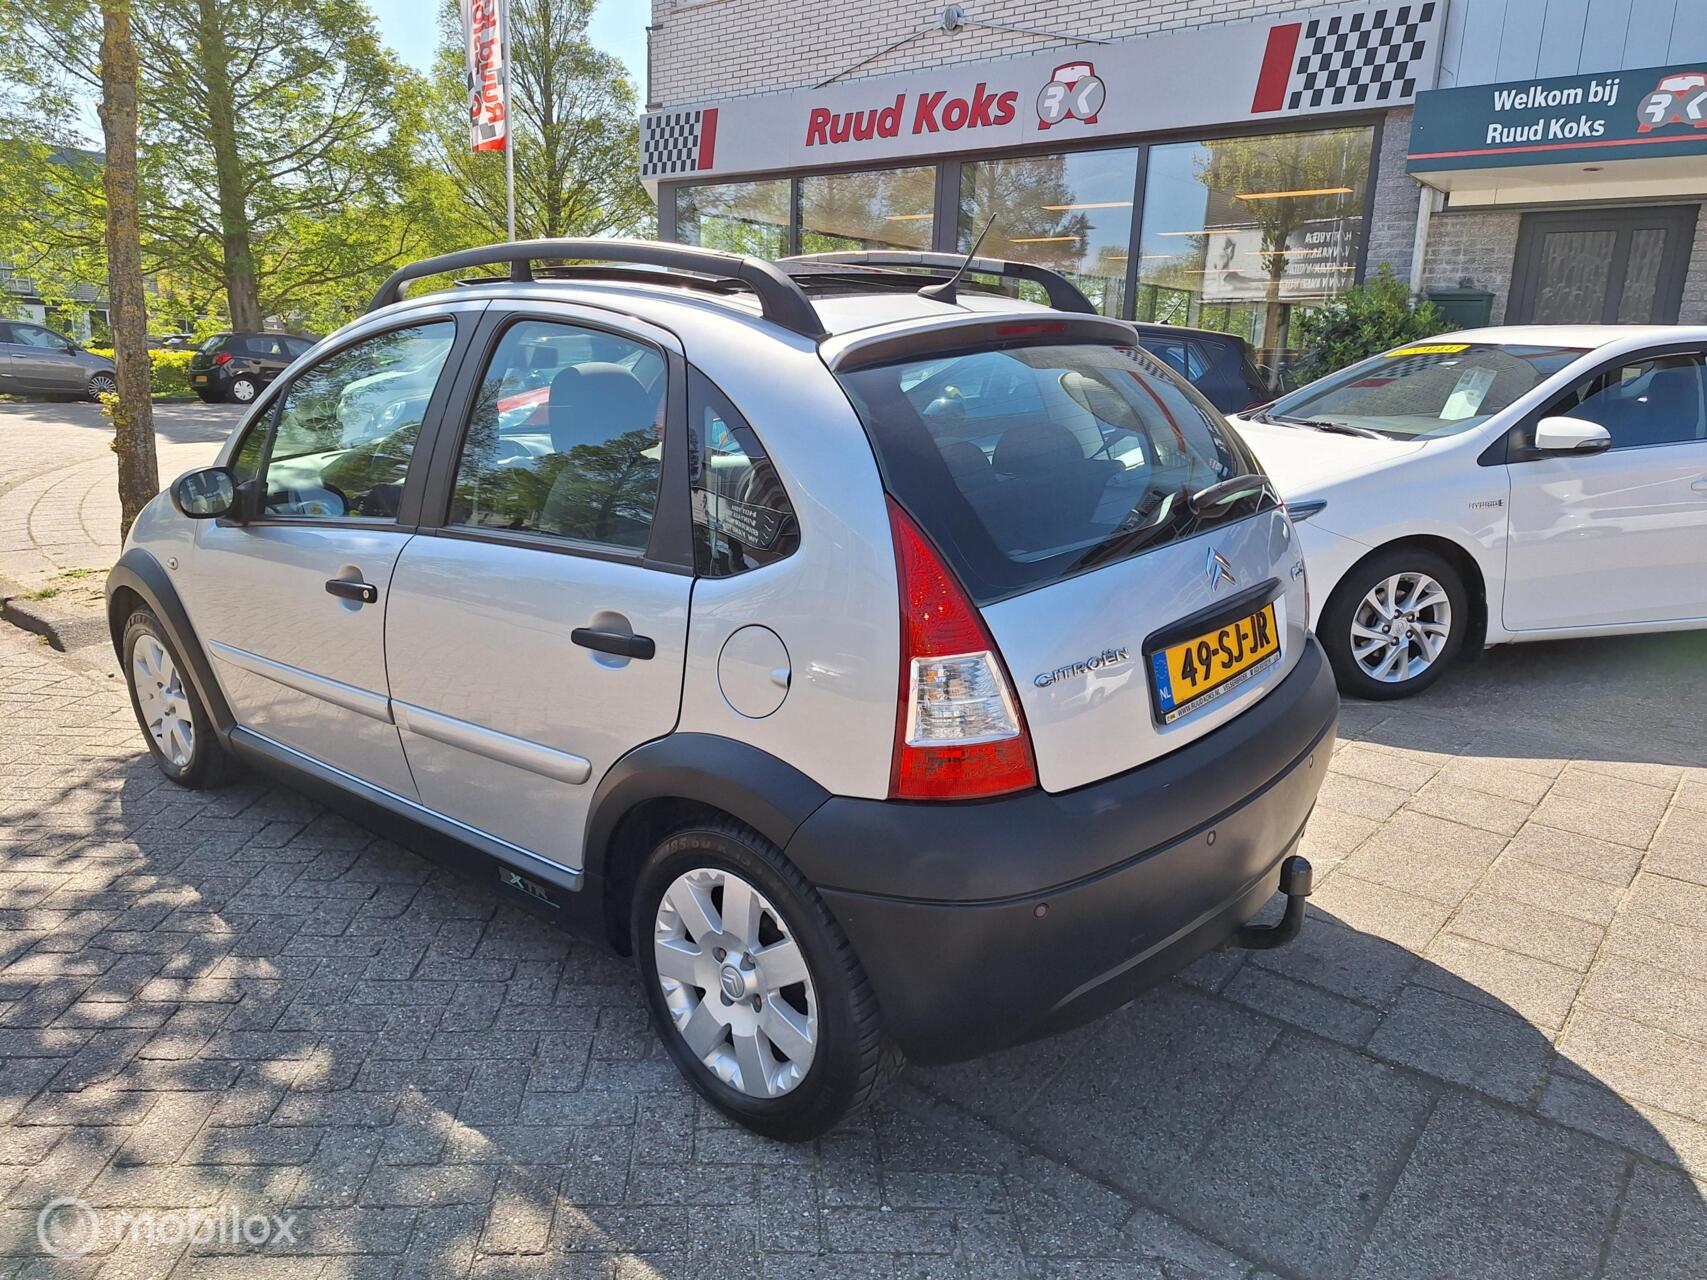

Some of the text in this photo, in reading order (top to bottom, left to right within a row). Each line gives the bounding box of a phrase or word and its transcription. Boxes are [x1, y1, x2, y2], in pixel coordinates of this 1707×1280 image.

[1494, 78, 1620, 112] Welkom bij
[805, 82, 1018, 147] Ruud Koks
[1486, 115, 1605, 144] Ruud Koks
[1033, 647, 1130, 688] CITROËN
[1181, 611, 1271, 687] 49-SJ-JR
[1160, 687, 1171, 701] NL
